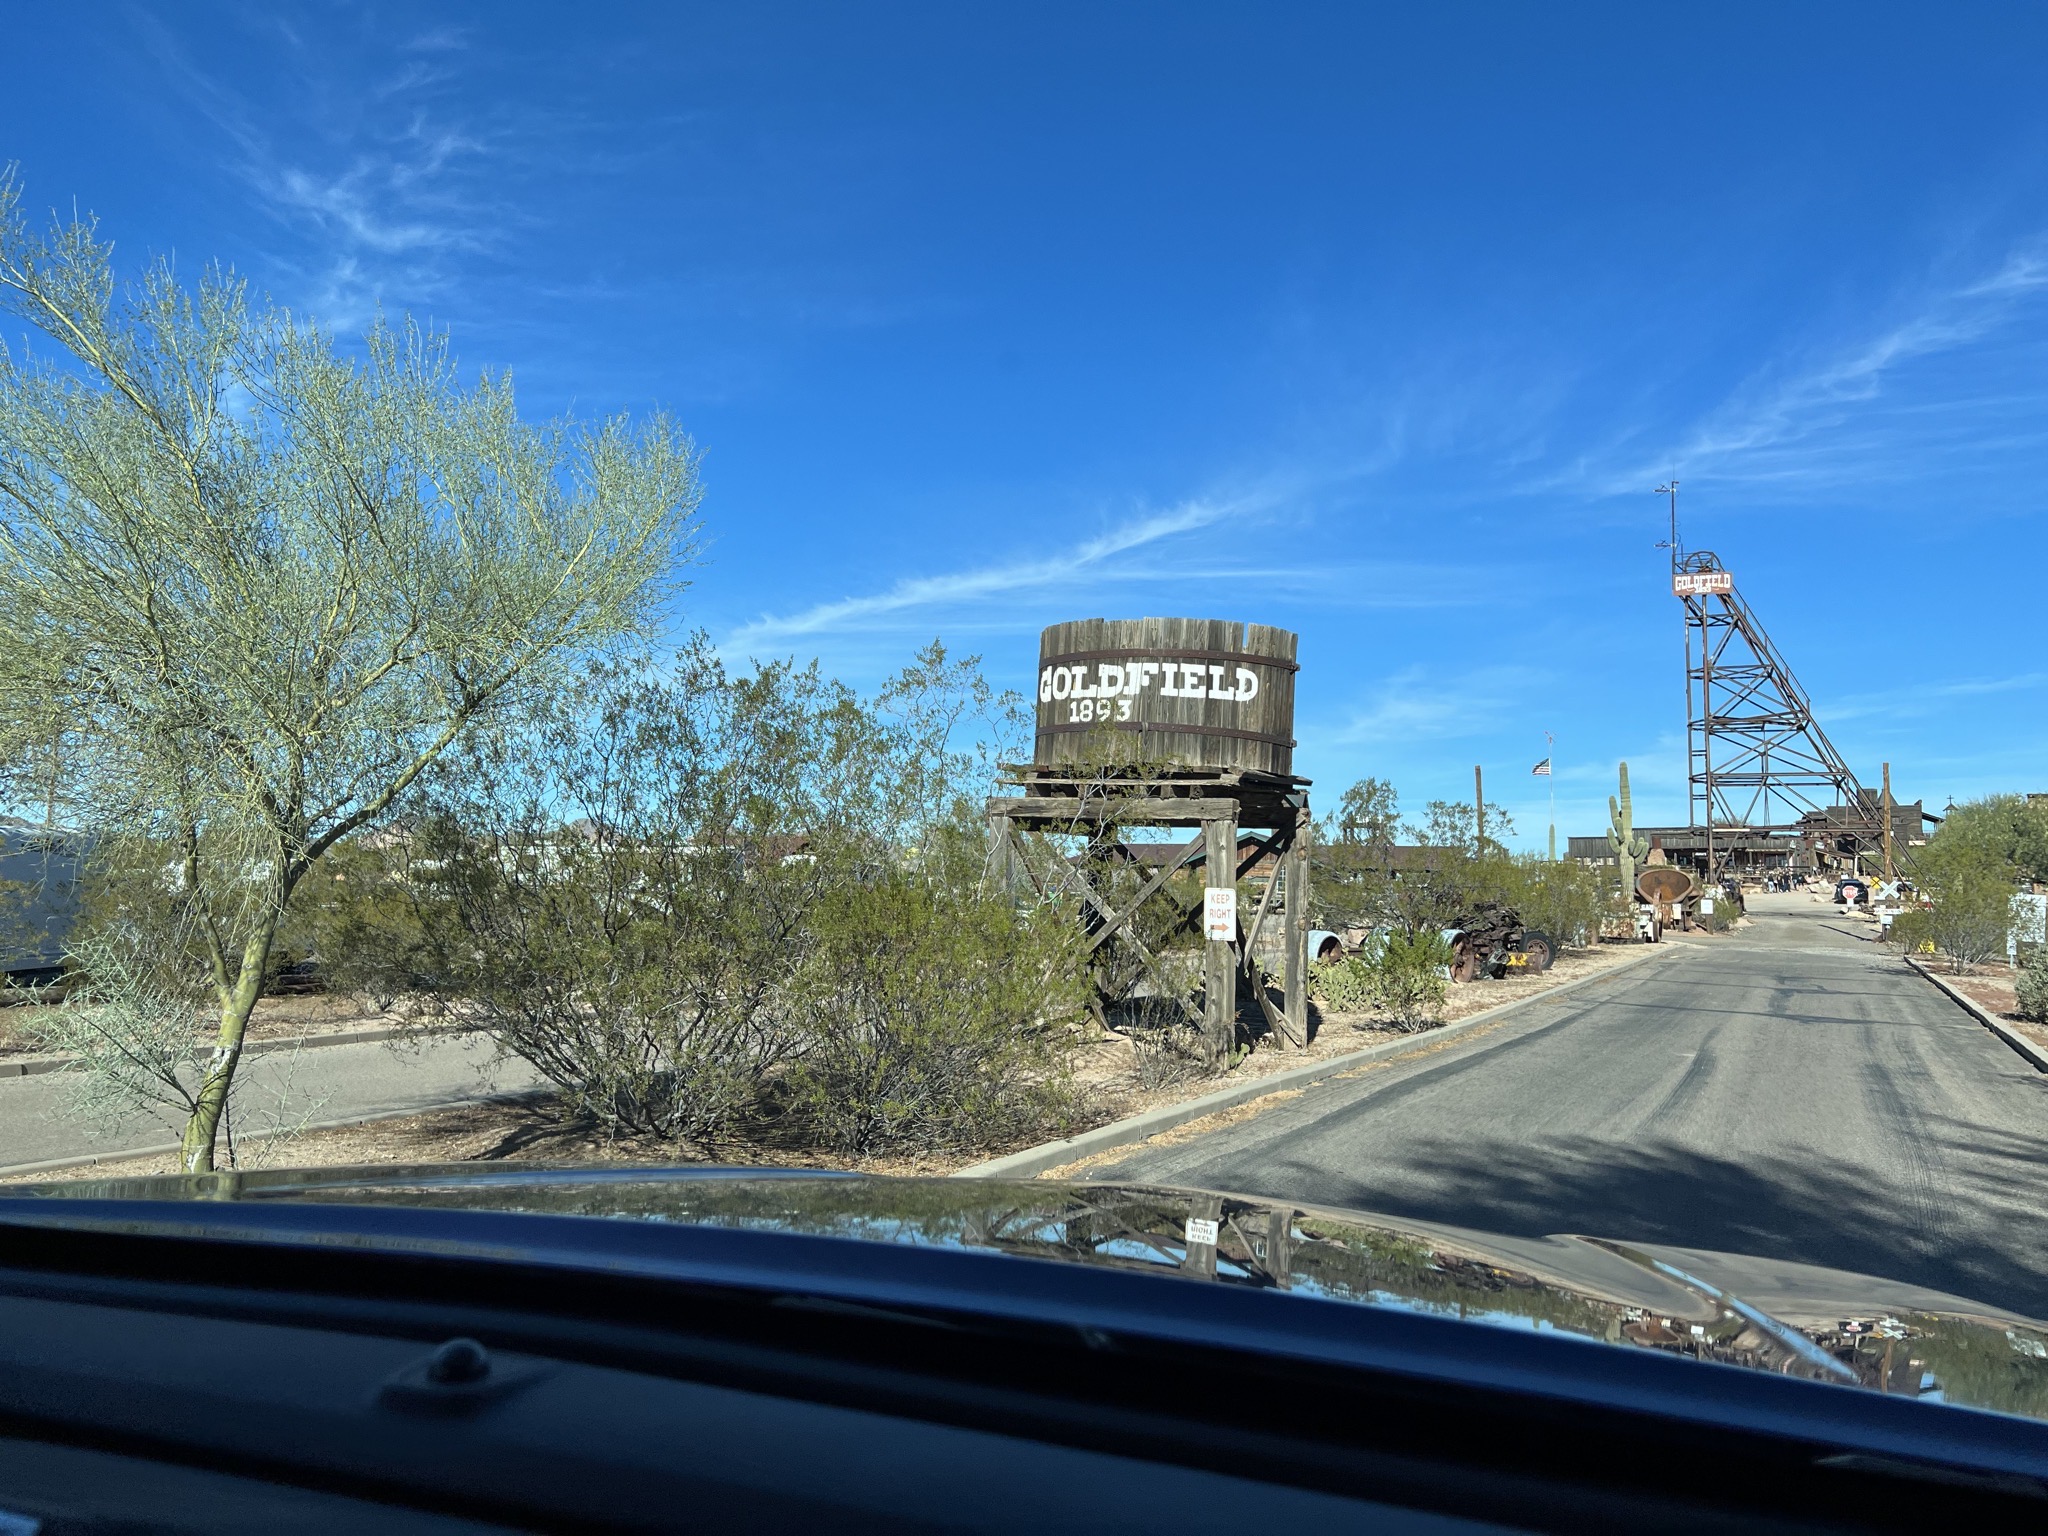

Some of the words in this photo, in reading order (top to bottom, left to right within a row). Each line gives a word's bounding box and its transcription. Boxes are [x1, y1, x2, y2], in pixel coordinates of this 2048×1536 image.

[1675, 574, 1731, 591] GOLDFIELD
[1039, 663, 1259, 703] GOLDFIELD
[1069, 699, 1132, 723] 1893
[1210, 893, 1230, 904] KEEP
[1209, 908, 1232, 919] RIGHT
